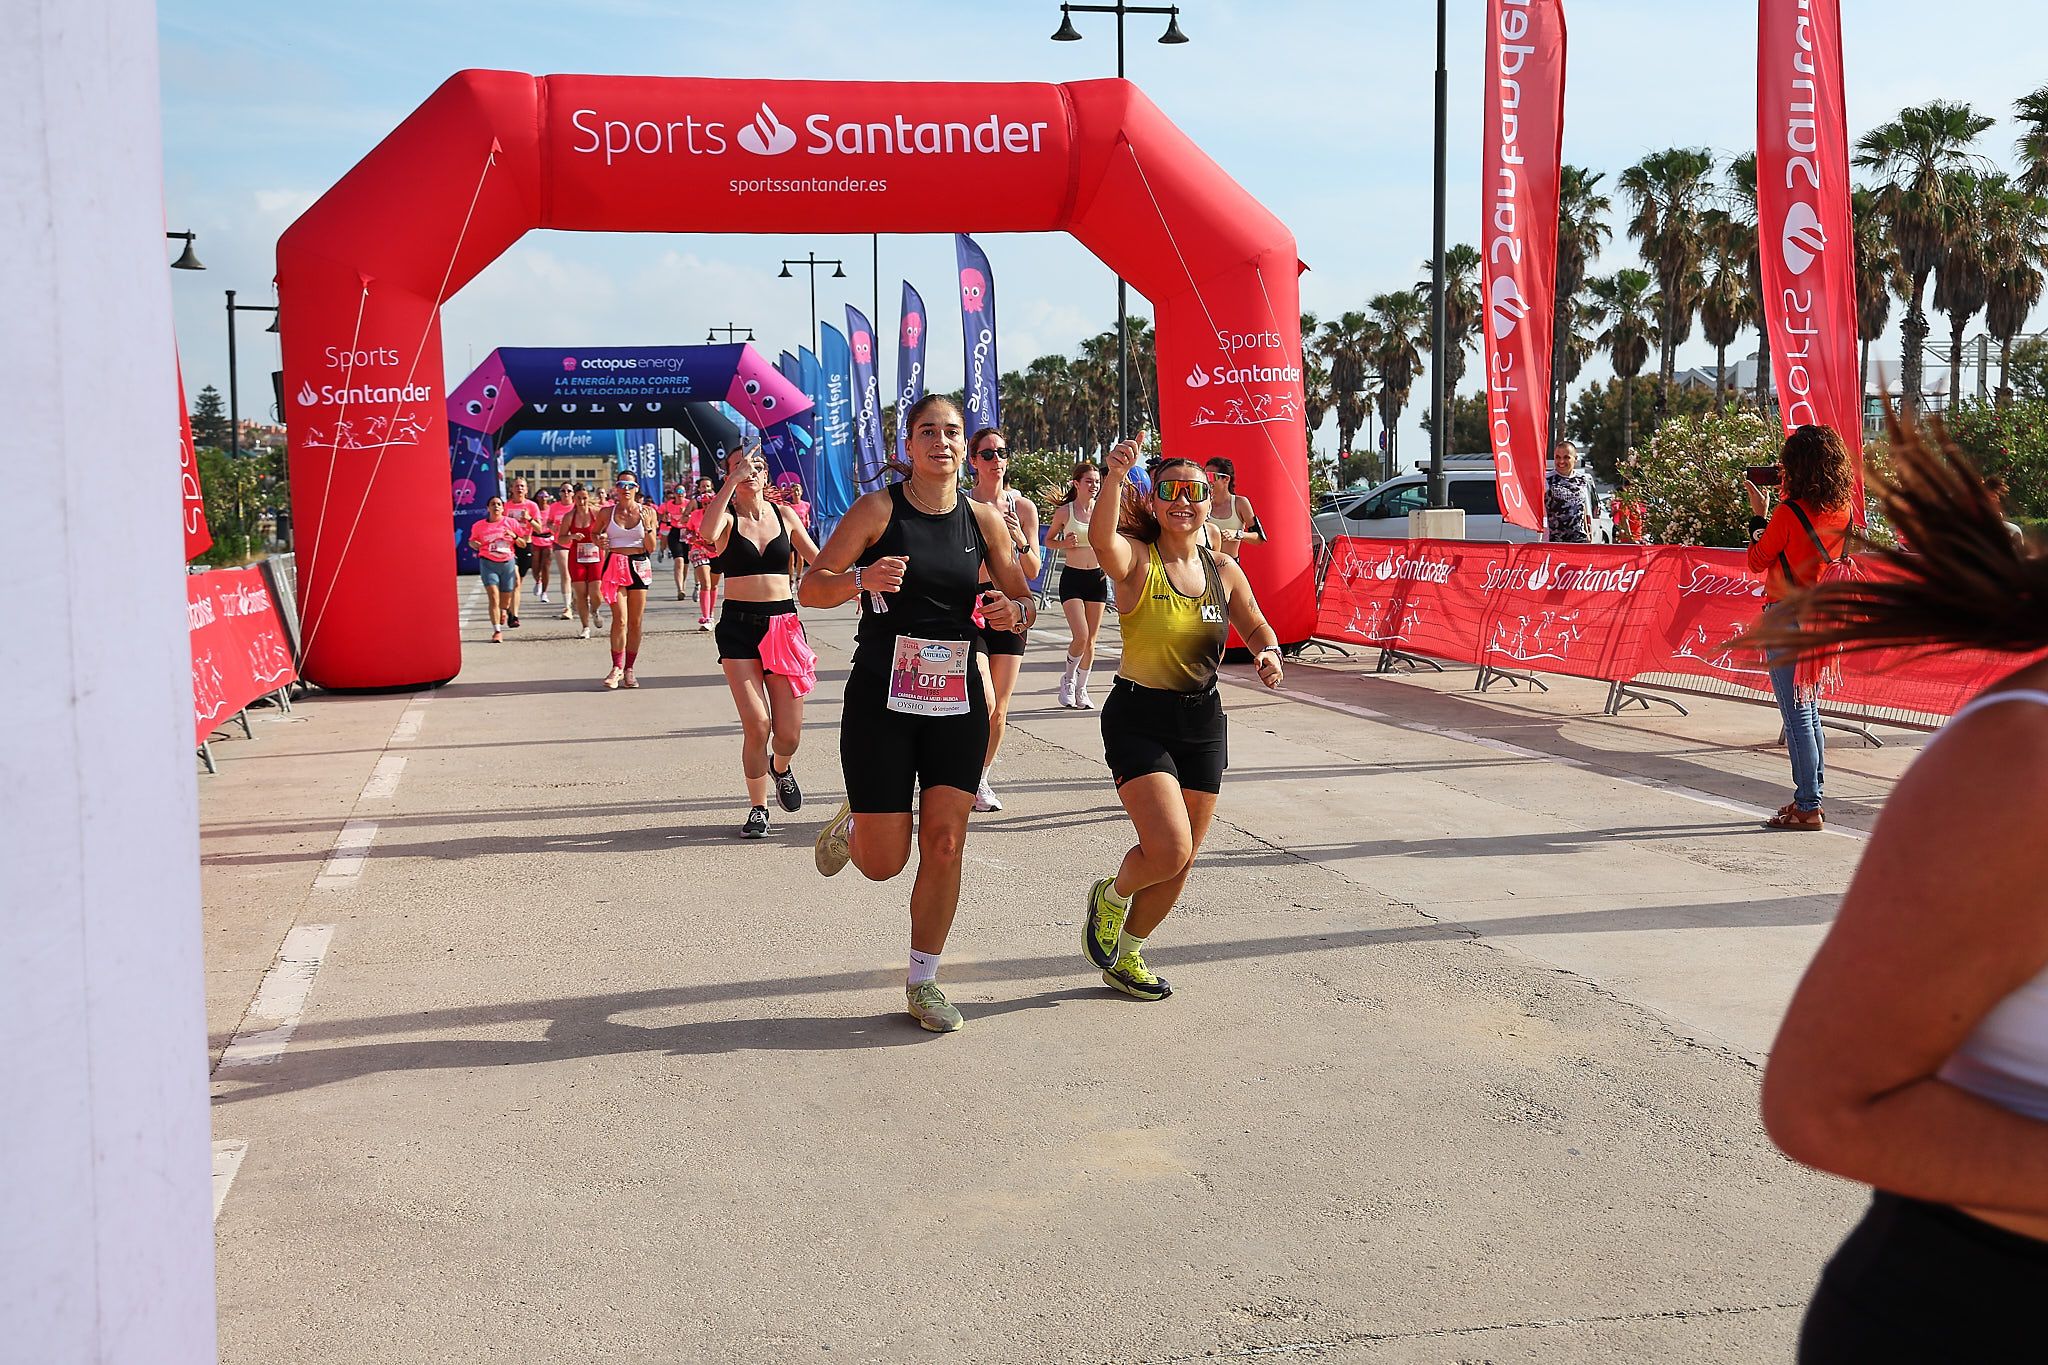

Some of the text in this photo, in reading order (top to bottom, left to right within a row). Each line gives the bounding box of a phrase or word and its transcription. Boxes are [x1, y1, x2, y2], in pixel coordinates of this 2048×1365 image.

[572, 108, 1048, 165] Sports Santander
[729, 176, 887, 196] sportssantander.es
[1218, 330, 1281, 354] Sports
[325, 346, 400, 373] Sports
[581, 358, 684, 372] octopus energy
[555, 376, 690, 386] LA ENERGÍA PARA CORRER
[1213, 364, 1300, 385] Santander
[321, 382, 432, 405] Santander
[554, 386, 692, 396] A LA VELOCIDAD DE LA LUZ
[541, 430, 592, 453] Marlene
[1343, 552, 1456, 585] Sports Santander
[1480, 560, 1646, 596] Sports Santander
[1677, 563, 1753, 598] Sports
